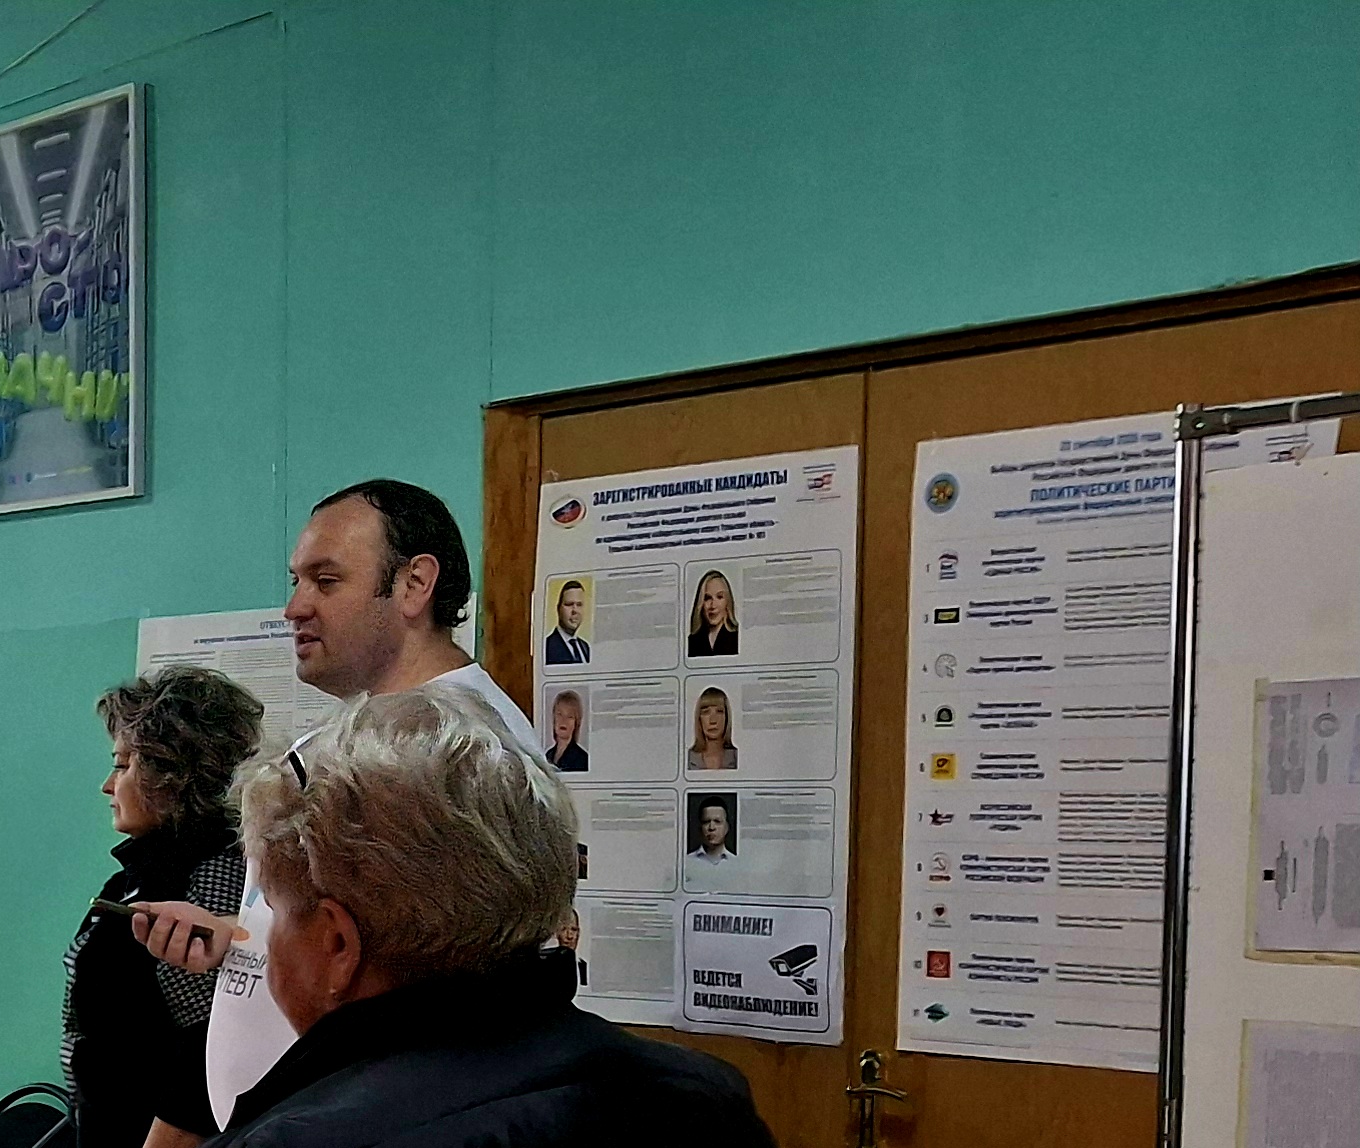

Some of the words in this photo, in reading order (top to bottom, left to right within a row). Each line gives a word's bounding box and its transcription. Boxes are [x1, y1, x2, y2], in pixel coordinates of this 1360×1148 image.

[592, 477, 713, 507] ЗАРЕГИСТРИРОВАННЫЕ
[715, 469, 788, 492] КАНДИДАТЫ
[1030, 479, 1131, 503] ПОЛИТИЧЕСКИЕ
[1134, 475, 1176, 493] ПАРТИ
[693, 914, 774, 937] ВНИМАНИЕ!
[693, 969, 743, 988] ВЕДЕТСЯ
[693, 991, 819, 1018] ВИДЕОНАБЛЮДЕНИЕ!
